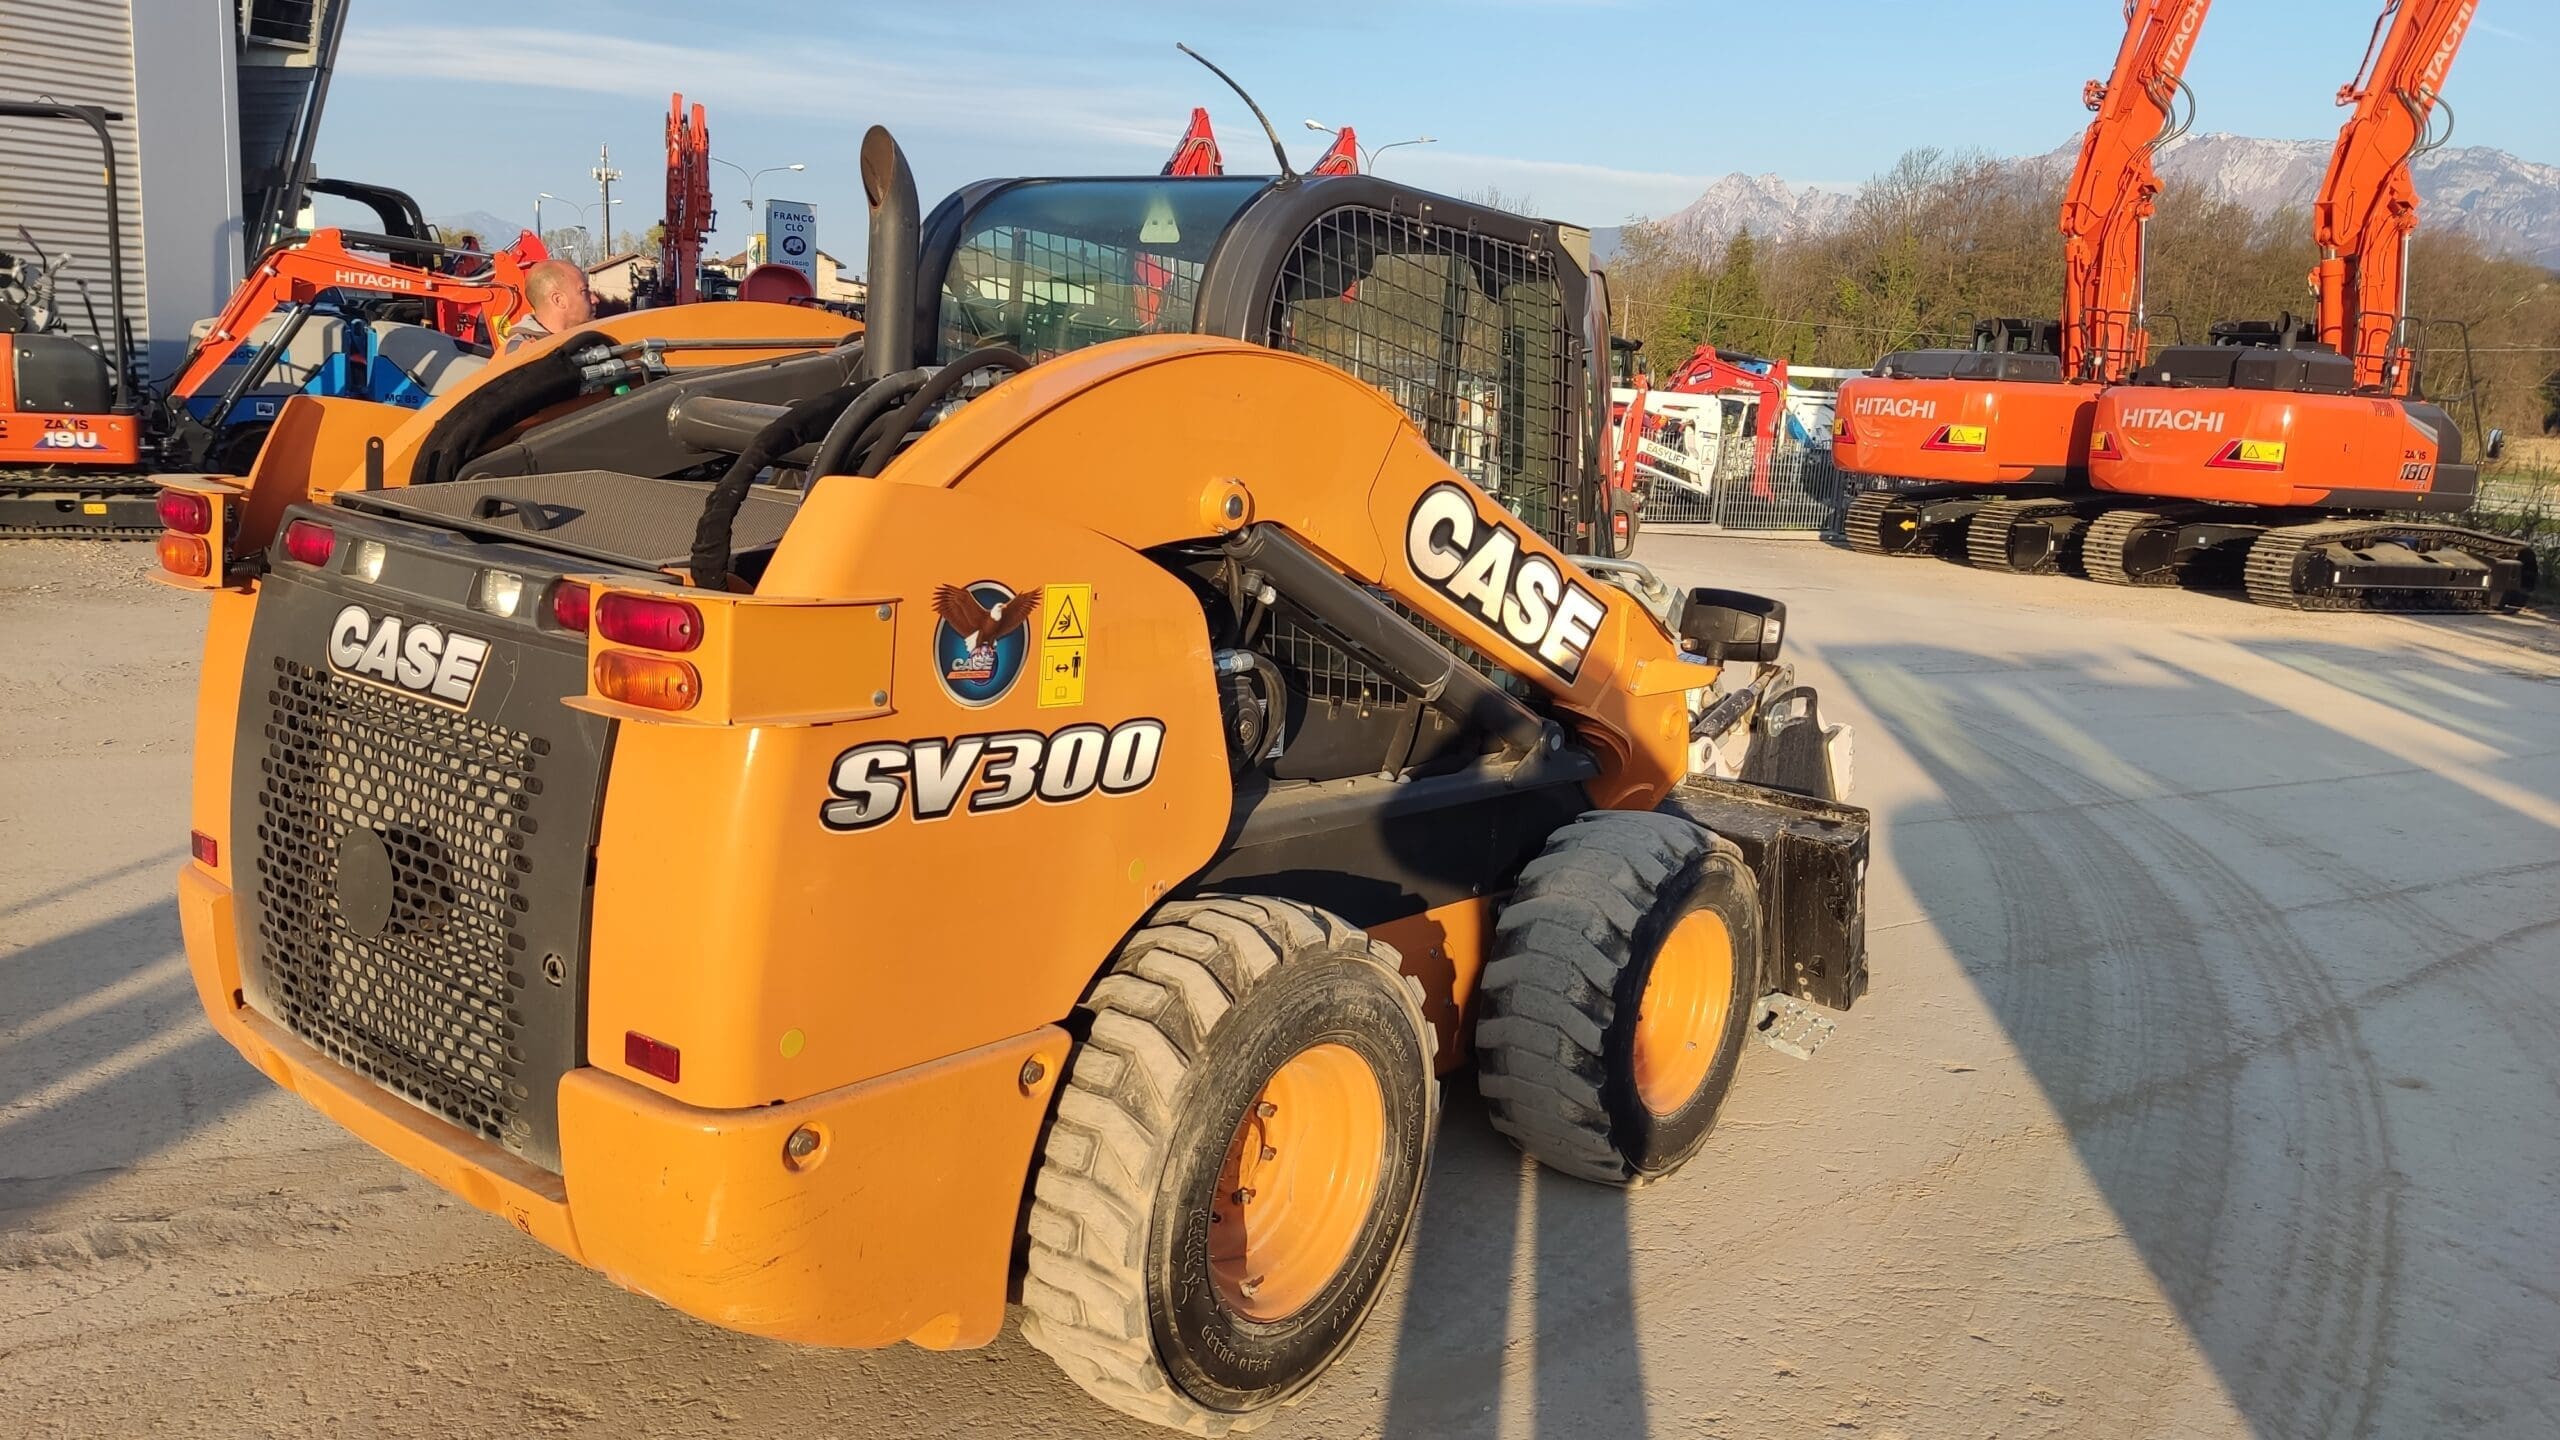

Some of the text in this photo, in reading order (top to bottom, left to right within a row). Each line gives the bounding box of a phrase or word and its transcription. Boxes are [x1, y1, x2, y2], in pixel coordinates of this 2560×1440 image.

[773, 211, 815, 223] FRANCO
[335, 269, 411, 290] HITACHI
[1854, 397, 1937, 420] HITACHI
[44, 418, 89, 431] ZAXIS
[2121, 408, 2225, 433] HITACHI
[44, 431, 97, 448] 19U
[1646, 443, 1687, 466] EASYLIFT
[2400, 463, 2432, 481] 180
[1406, 481, 1607, 676] CASE
[329, 605, 488, 703] CASE
[951, 656, 995, 671] CASE
[819, 717, 1167, 831] SV300
